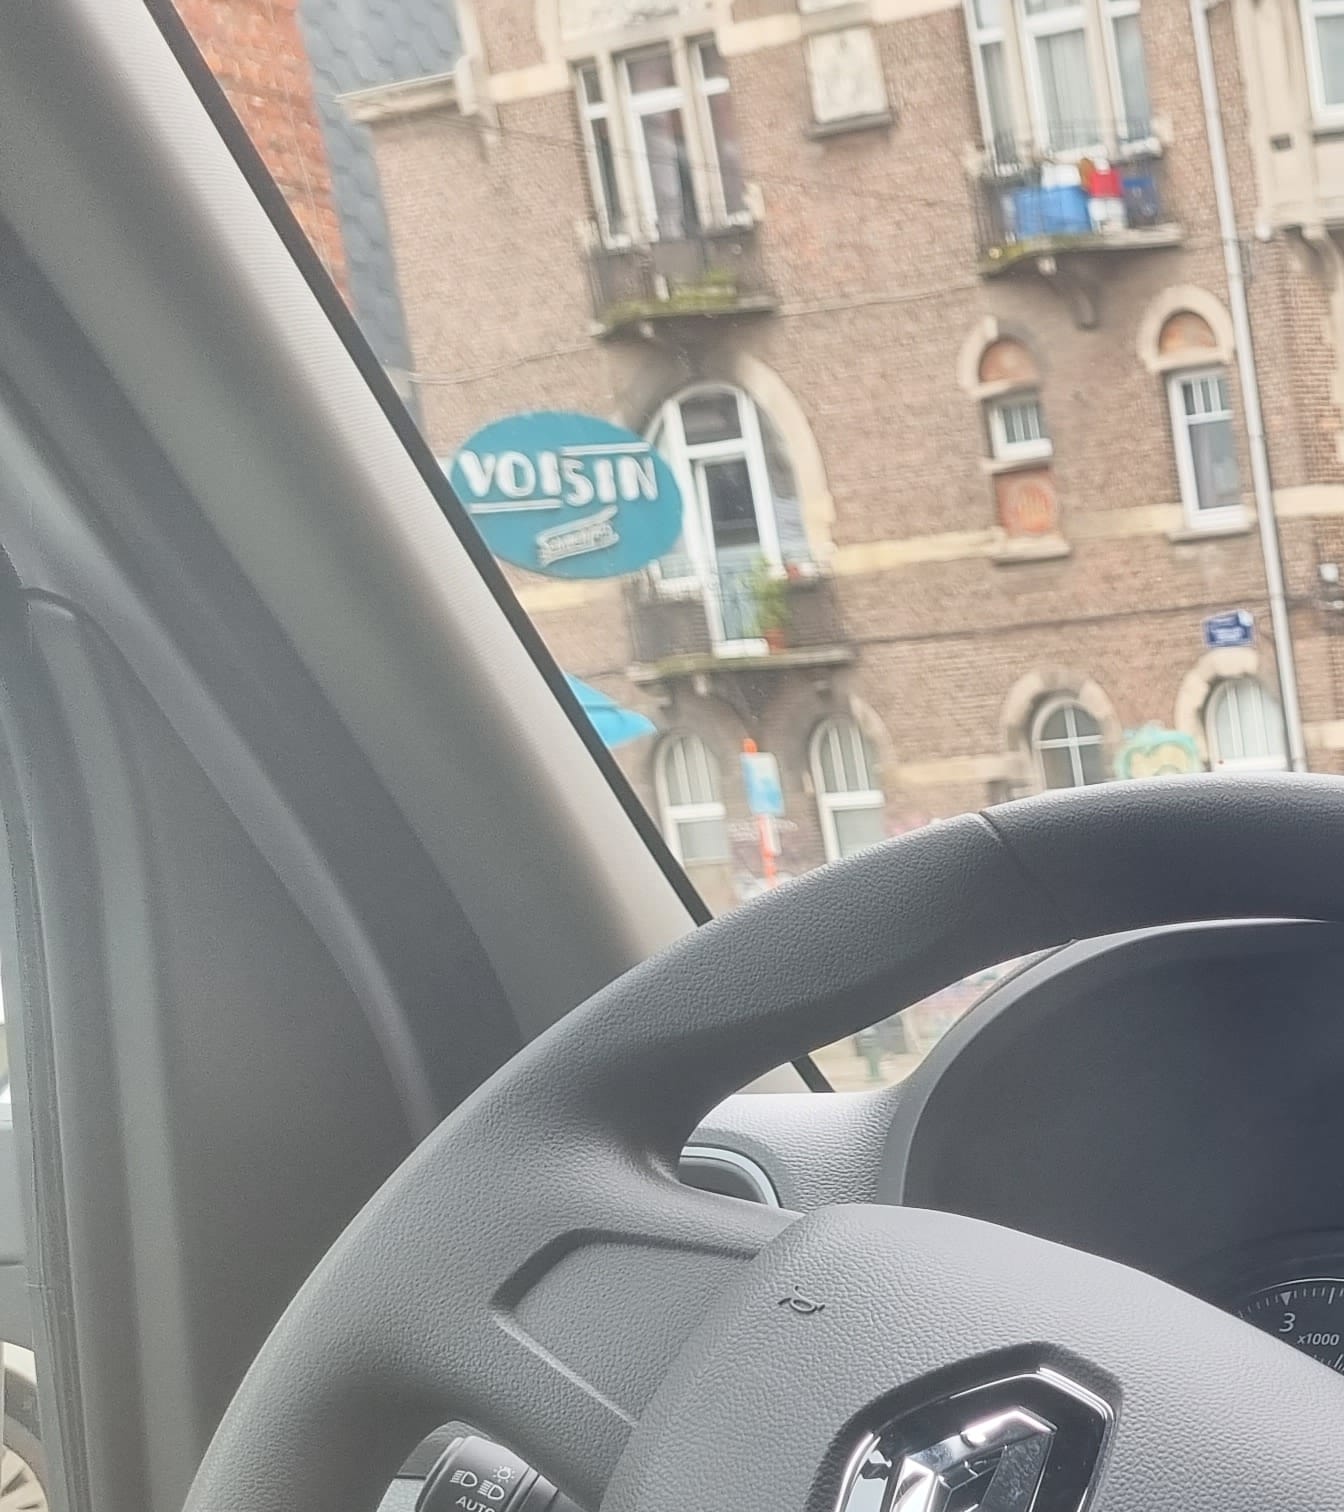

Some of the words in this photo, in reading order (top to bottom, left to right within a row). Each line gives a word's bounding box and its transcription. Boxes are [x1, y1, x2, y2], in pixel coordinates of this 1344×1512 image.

[457, 449, 659, 507] VOISIN
[1279, 1312, 1296, 1333] 3
[1297, 1333, 1340, 1346] x1000
